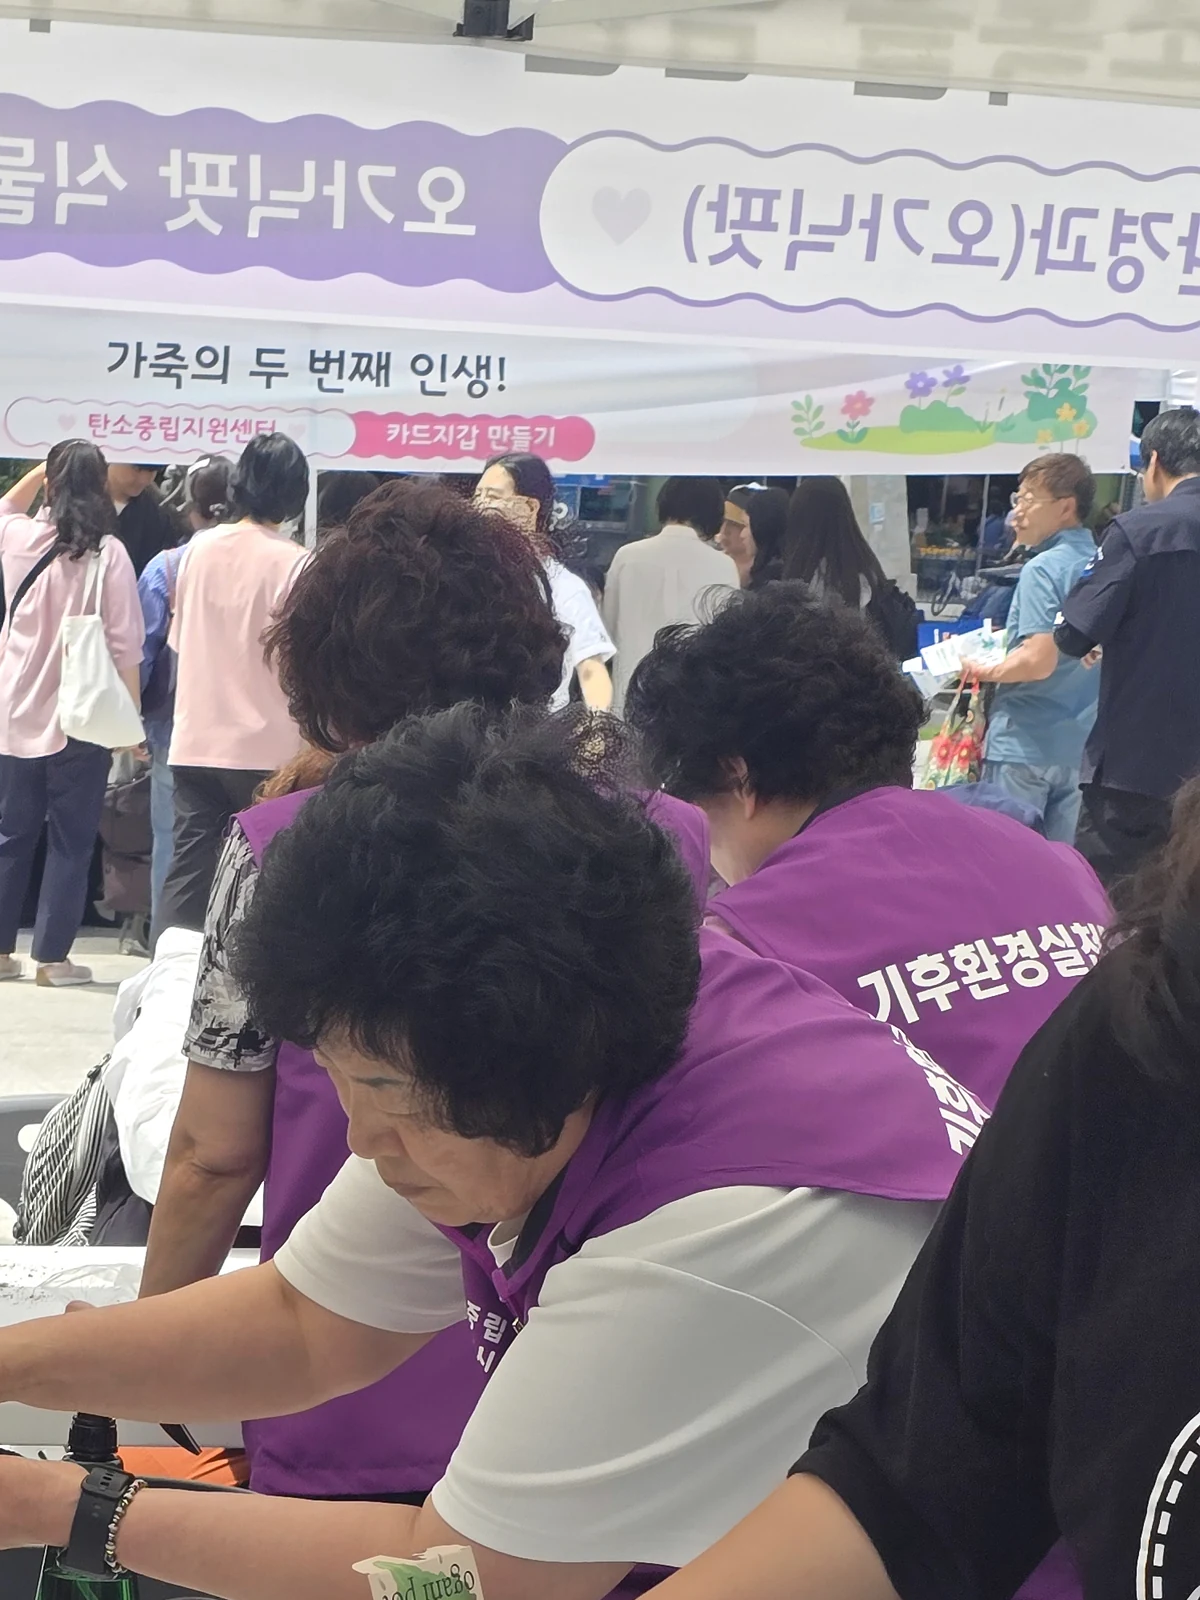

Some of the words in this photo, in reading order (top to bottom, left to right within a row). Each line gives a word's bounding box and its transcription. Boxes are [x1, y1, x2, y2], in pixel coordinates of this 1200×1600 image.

[107, 341, 231, 389] 가죽의
[249, 348, 289, 389] 두
[309, 349, 390, 394] 번째
[410, 352, 506, 398] 인생!
[88, 412, 277, 445] 탄소중립지원센터
[386, 422, 480, 450] 카드지갑
[487, 424, 556, 451] 만들기
